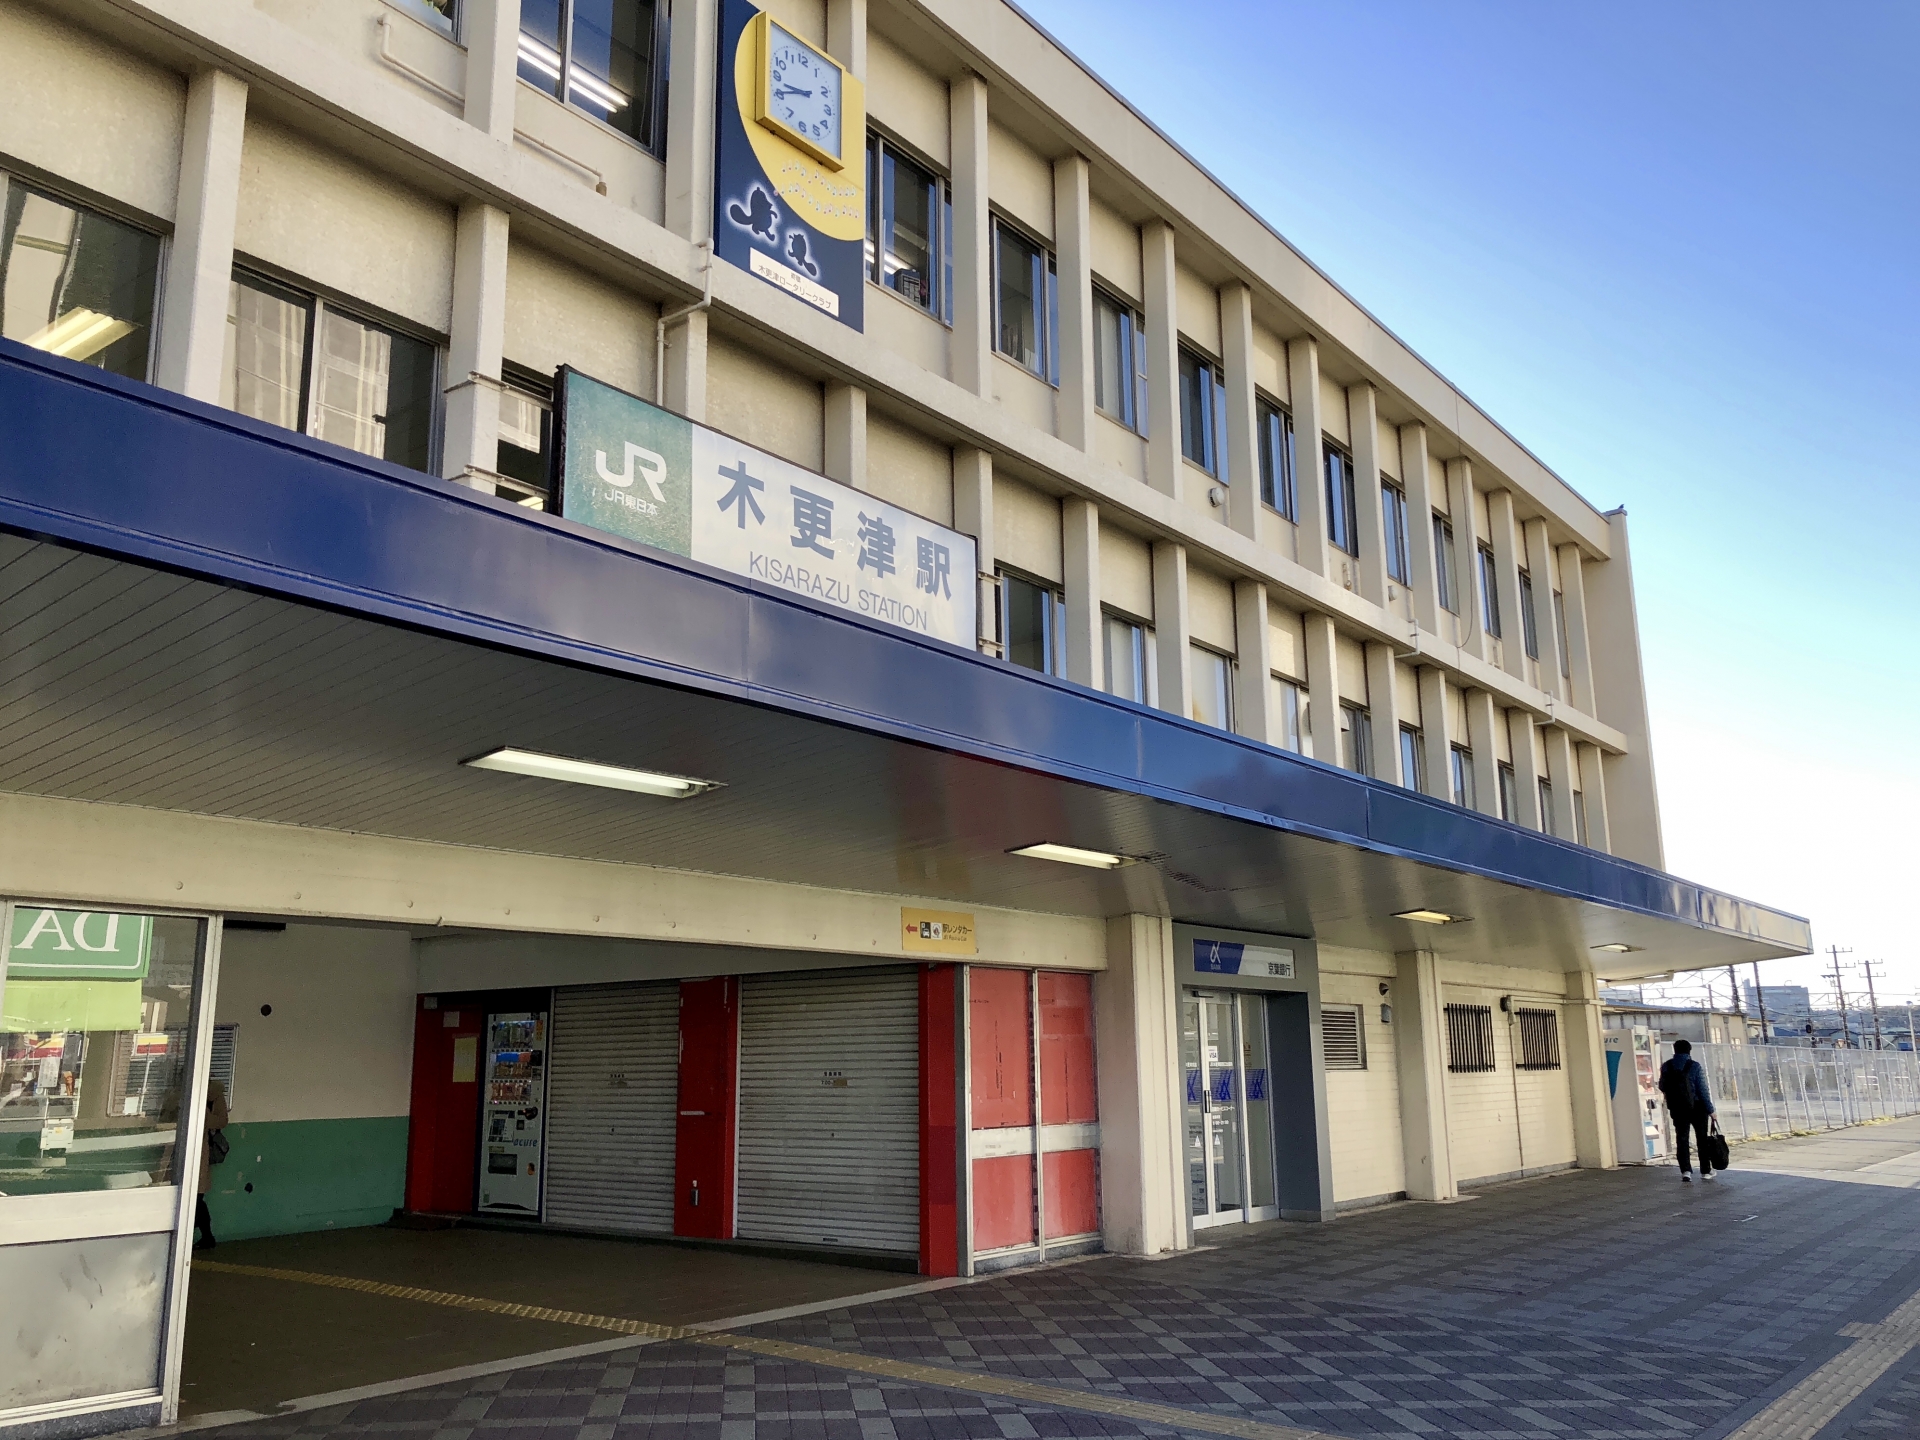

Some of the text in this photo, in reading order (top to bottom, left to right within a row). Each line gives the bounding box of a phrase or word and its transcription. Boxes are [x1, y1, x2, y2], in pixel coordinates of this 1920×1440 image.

[775, 56, 787, 71] 10
[784, 50, 794, 64] 11
[797, 53, 809, 68] 12
[772, 70, 782, 82] 9
[813, 68, 818, 78] 1
[820, 86, 829, 98] 2
[785, 107, 795, 118] 7
[823, 104, 832, 116] 3
[798, 121, 807, 133] 6
[812, 124, 821, 137] 5
[819, 119, 829, 130] 4
[758, 264, 832, 309] 木更津ロータリークラブ
[595, 441, 667, 503] JR
[604, 488, 658, 517] JR東日本
[716, 460, 952, 601] 木更津駅
[749, 551, 928, 632] KISARAZU STATION
[943, 923, 973, 935] 駅レンタカー
[1267, 962, 1291, 977] 京葉銀行
[513, 1138, 538, 1147] acure
